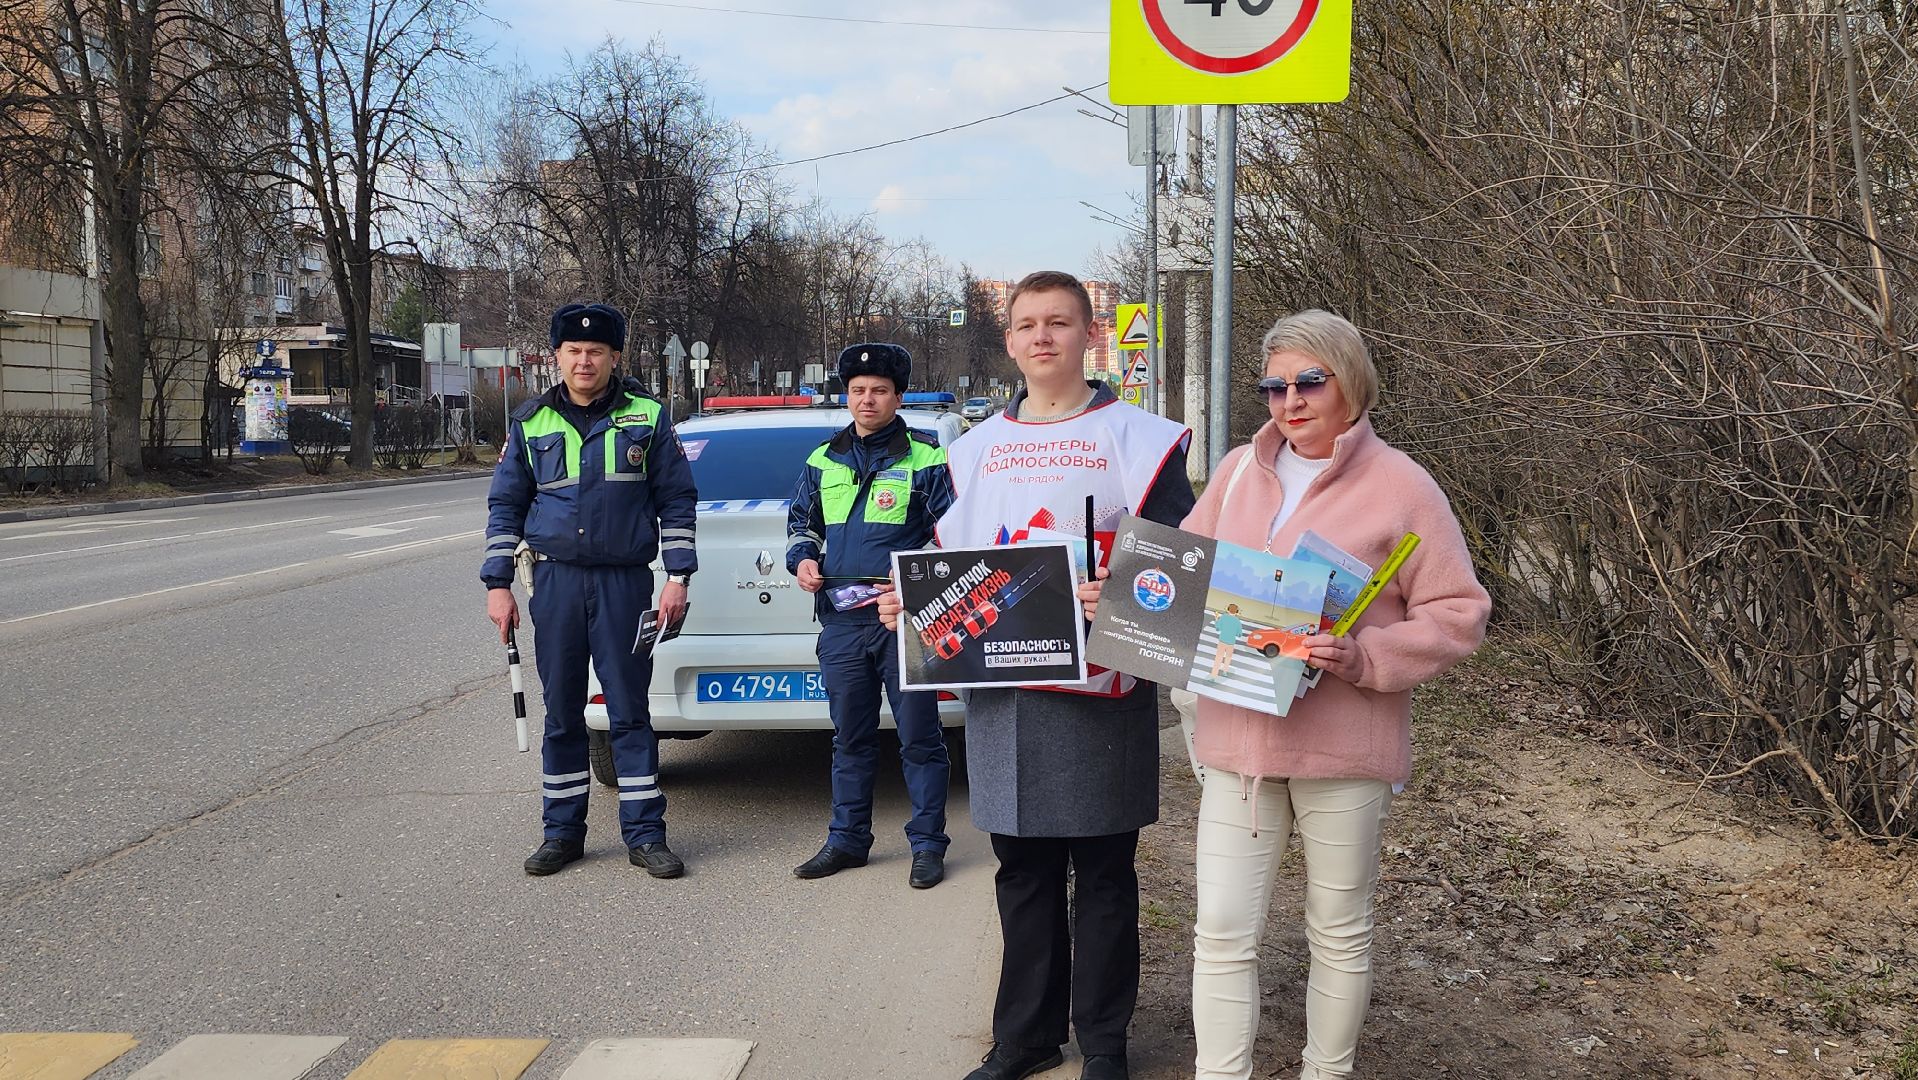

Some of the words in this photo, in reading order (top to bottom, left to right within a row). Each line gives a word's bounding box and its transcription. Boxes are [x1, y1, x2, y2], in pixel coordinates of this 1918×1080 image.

[1126, 390, 1134, 398] 20
[991, 439, 1096, 458] ВОЛОНТЕРЫ
[982, 455, 1108, 479] ПОДМОСКОВЬЯ
[1009, 476, 1026, 484] МЫ
[1028, 475, 1065, 484] РЯДОМ
[737, 580, 791, 589] LOGAN
[911, 597, 947, 631] ОДИН
[941, 558, 993, 607] ЩЕЛЧОК
[920, 598, 973, 646] СПАСАЕТ
[967, 568, 1012, 607] ЖИЗНЬ
[983, 639, 1071, 653] БЕЗОПАСНОСТЬ
[994, 655, 1021, 664] Ваших
[1023, 654, 1050, 664] руках!
[1138, 648, 1185, 667] ПОТЕРЯН!
[732, 675, 791, 698] 4794
